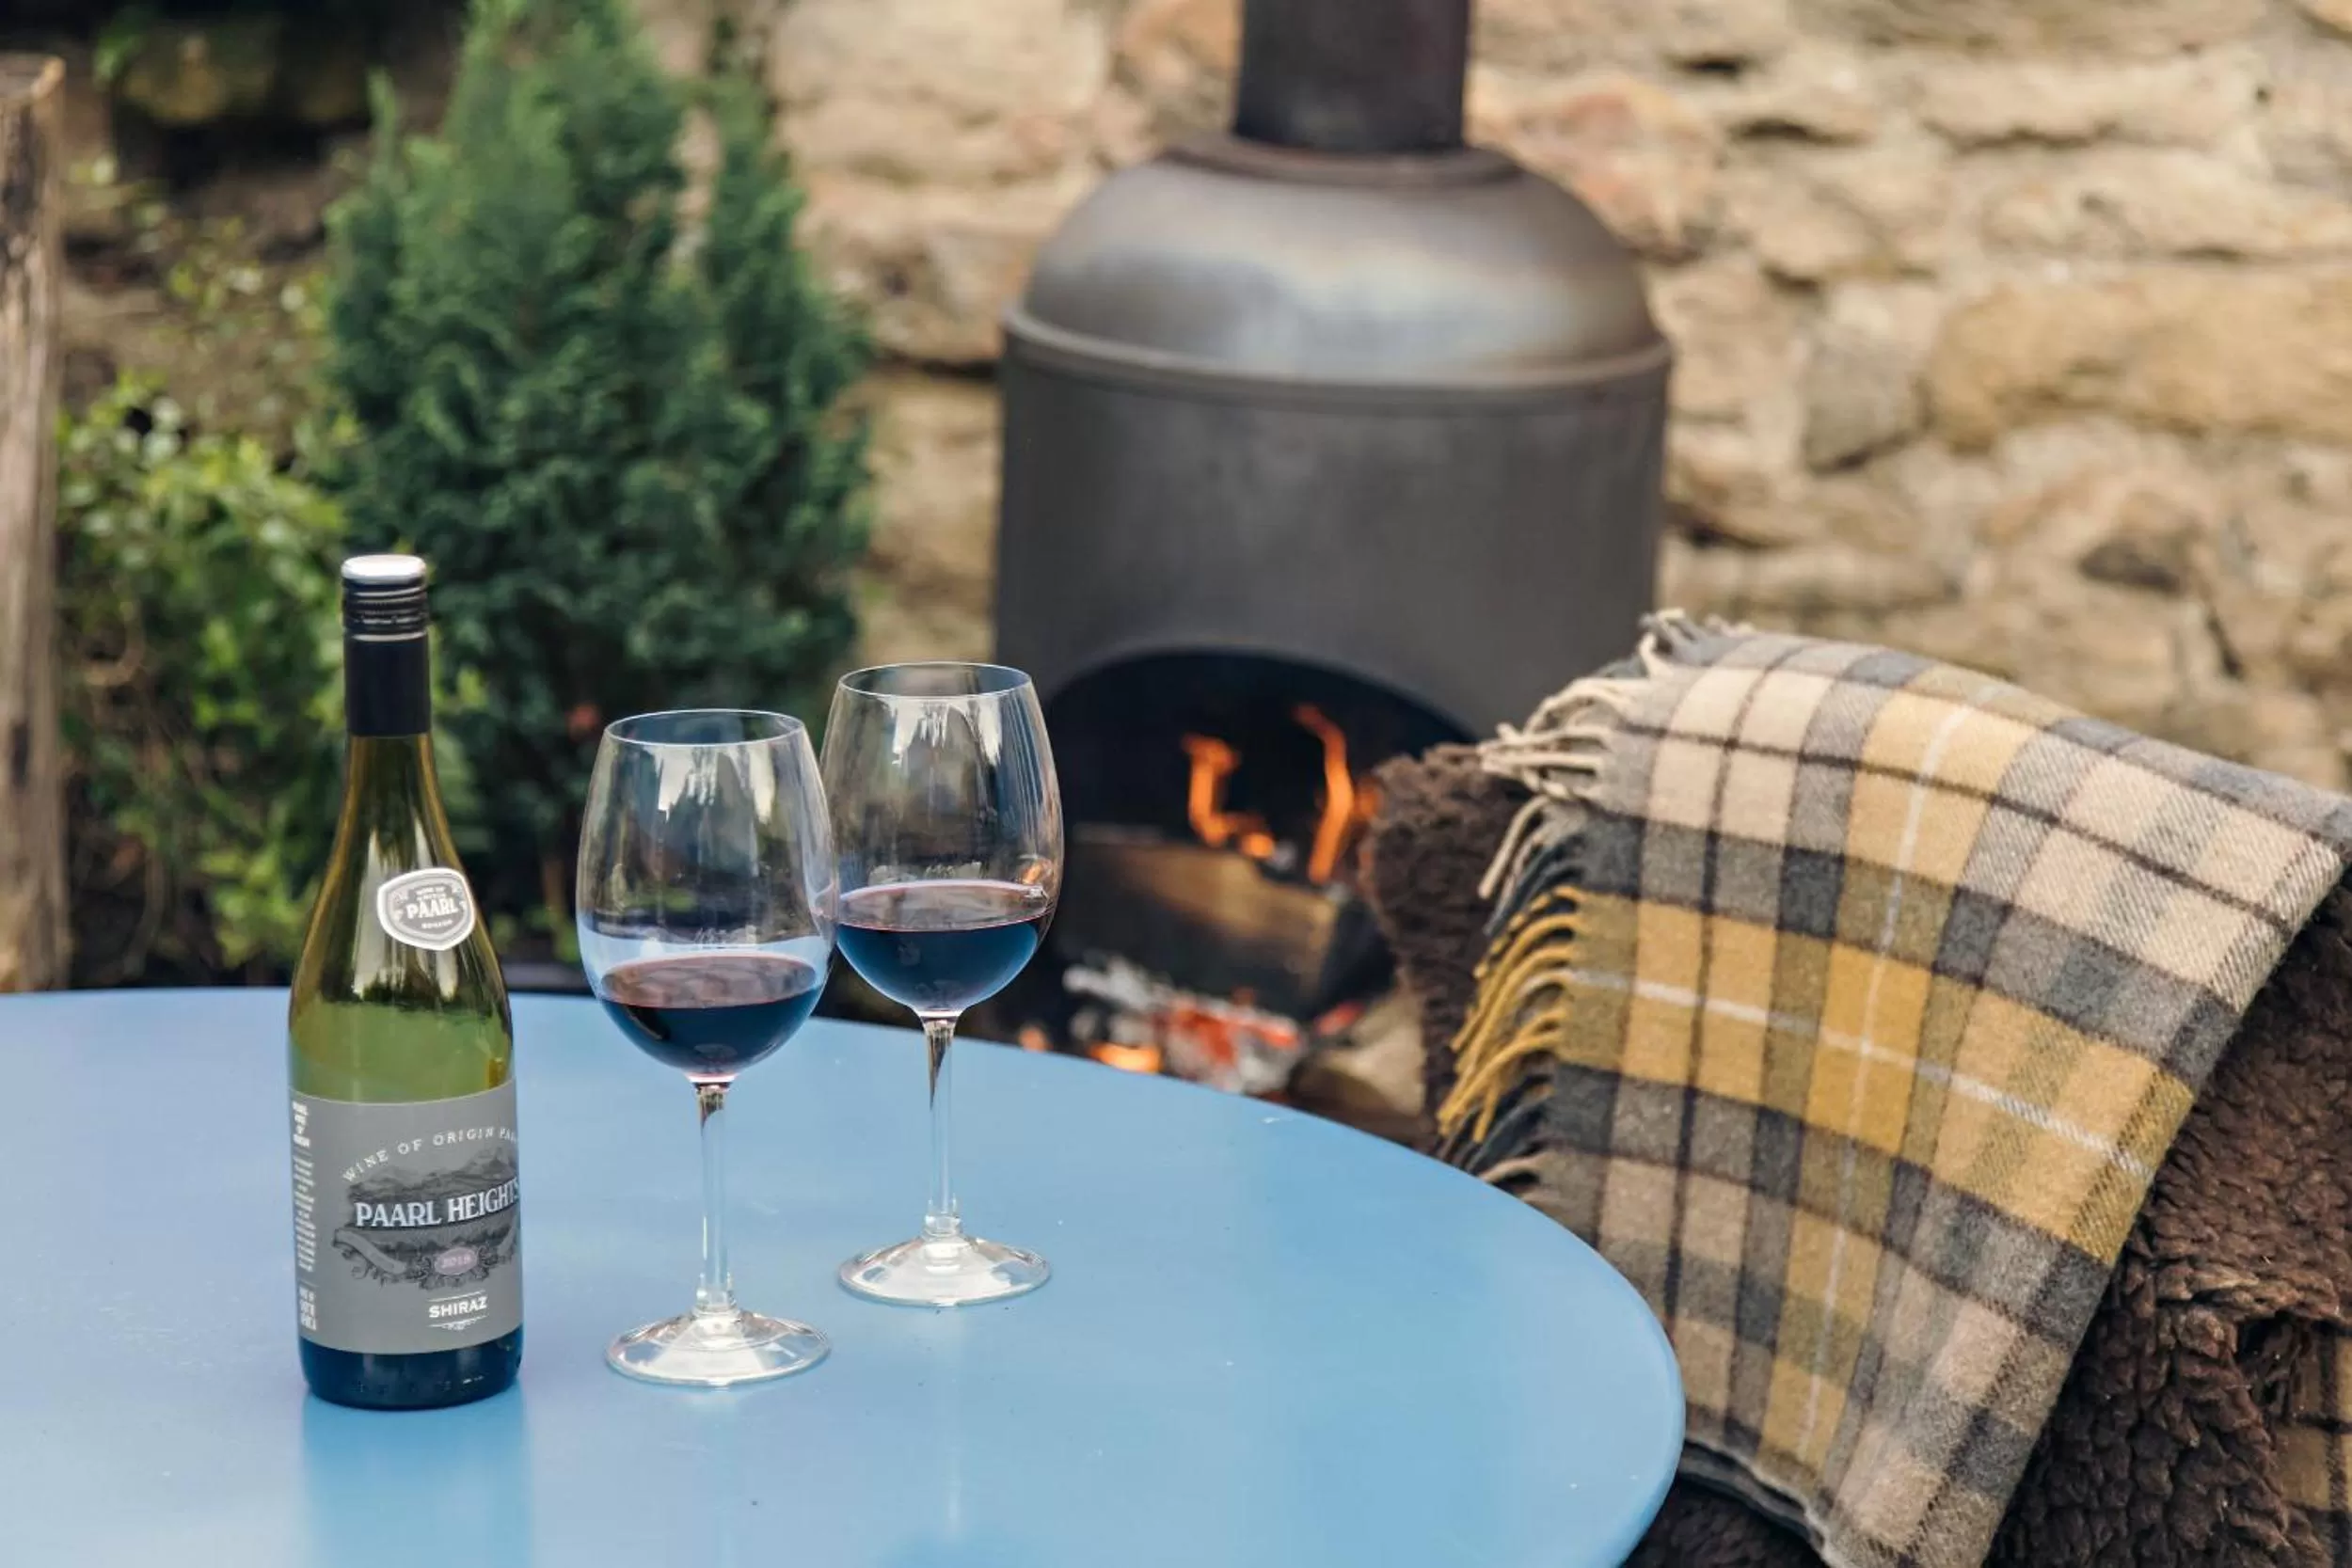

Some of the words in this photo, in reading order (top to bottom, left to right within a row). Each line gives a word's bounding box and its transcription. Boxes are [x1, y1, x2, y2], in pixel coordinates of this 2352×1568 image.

[406, 898, 458, 919] PAARL
[342, 1149, 389, 1182] WINE
[397, 1138, 423, 1155] OF
[432, 1127, 494, 1147] ORIGIN
[354, 1200, 443, 1227] PAARL
[428, 1295, 488, 1318] SHIRAZ
